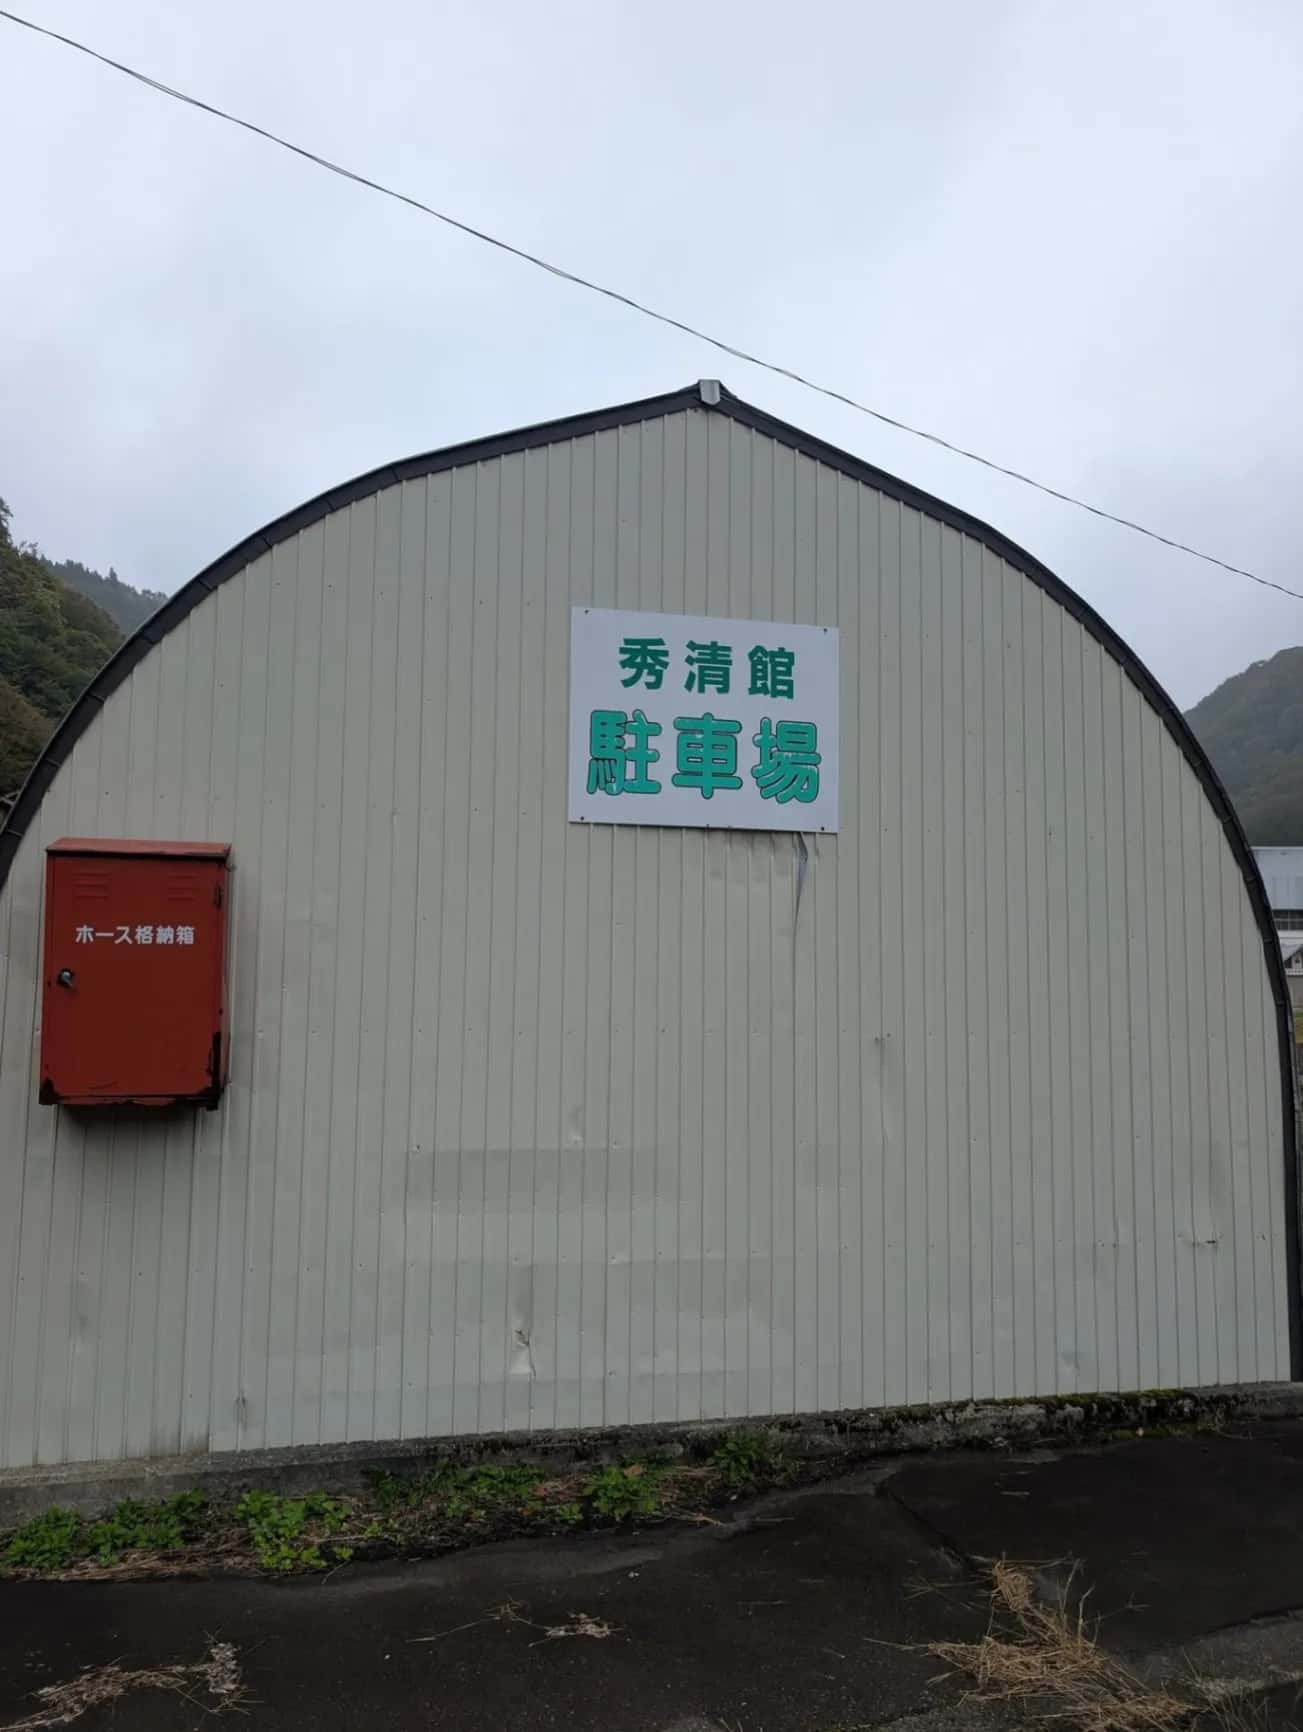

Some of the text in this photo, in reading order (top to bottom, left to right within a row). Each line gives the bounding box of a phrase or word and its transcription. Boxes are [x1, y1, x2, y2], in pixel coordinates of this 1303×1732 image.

[618, 637, 796, 700] 秀清館
[586, 709, 822, 805] 駐車場
[75, 924, 196, 946] ホース格納箱
